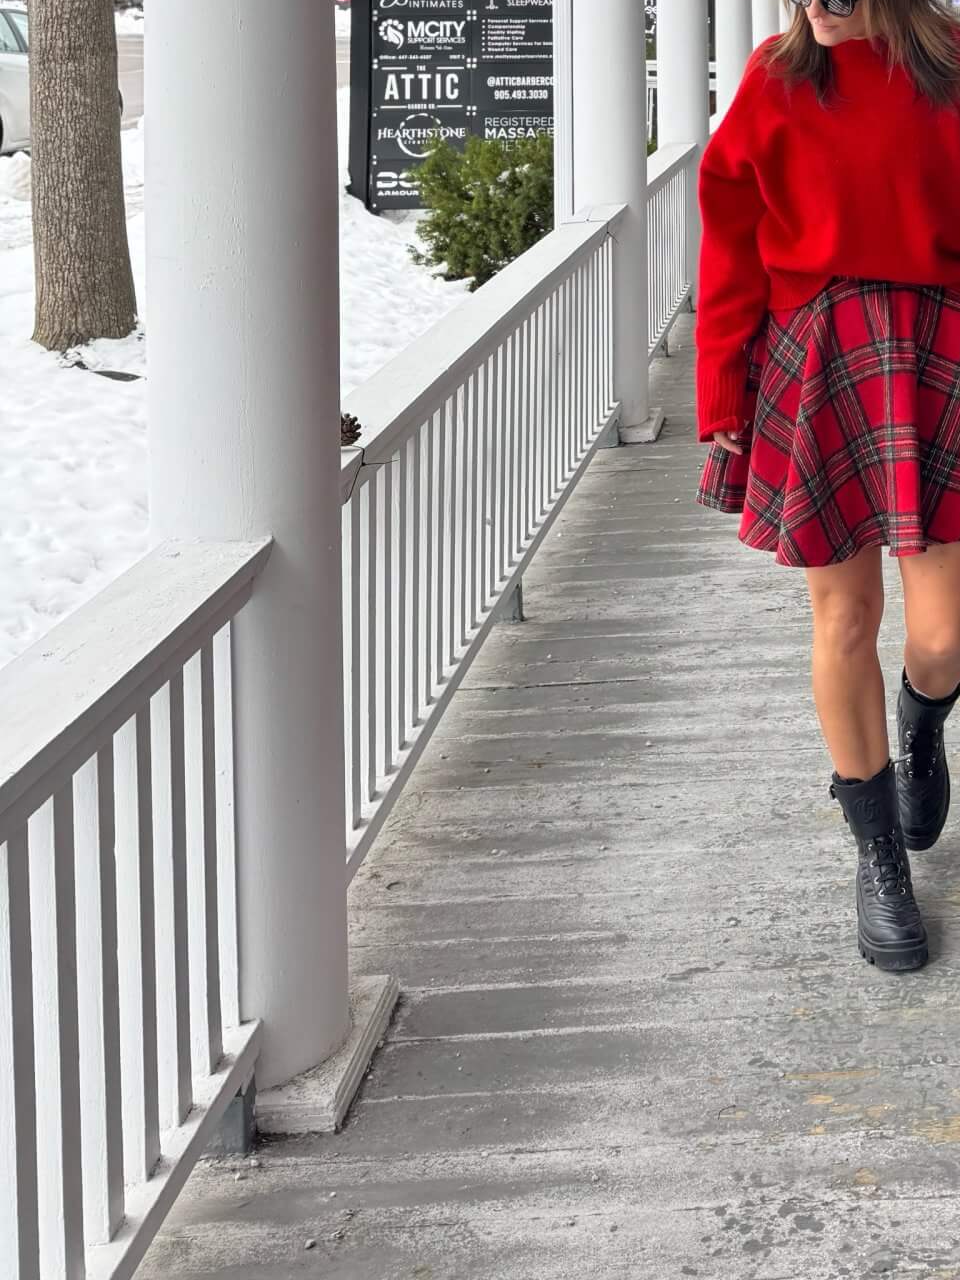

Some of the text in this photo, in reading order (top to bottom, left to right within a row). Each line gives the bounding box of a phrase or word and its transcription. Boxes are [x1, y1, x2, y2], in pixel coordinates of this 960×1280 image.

[408, 0, 464, 9] INTIMATES
[407, 20, 466, 38] MCITY
[384, 73, 459, 100] ATTIC
[484, 117, 554, 127] REGISTERED
[377, 126, 467, 140] HEARTHSTONE
[484, 127, 554, 139] MASSAGE
